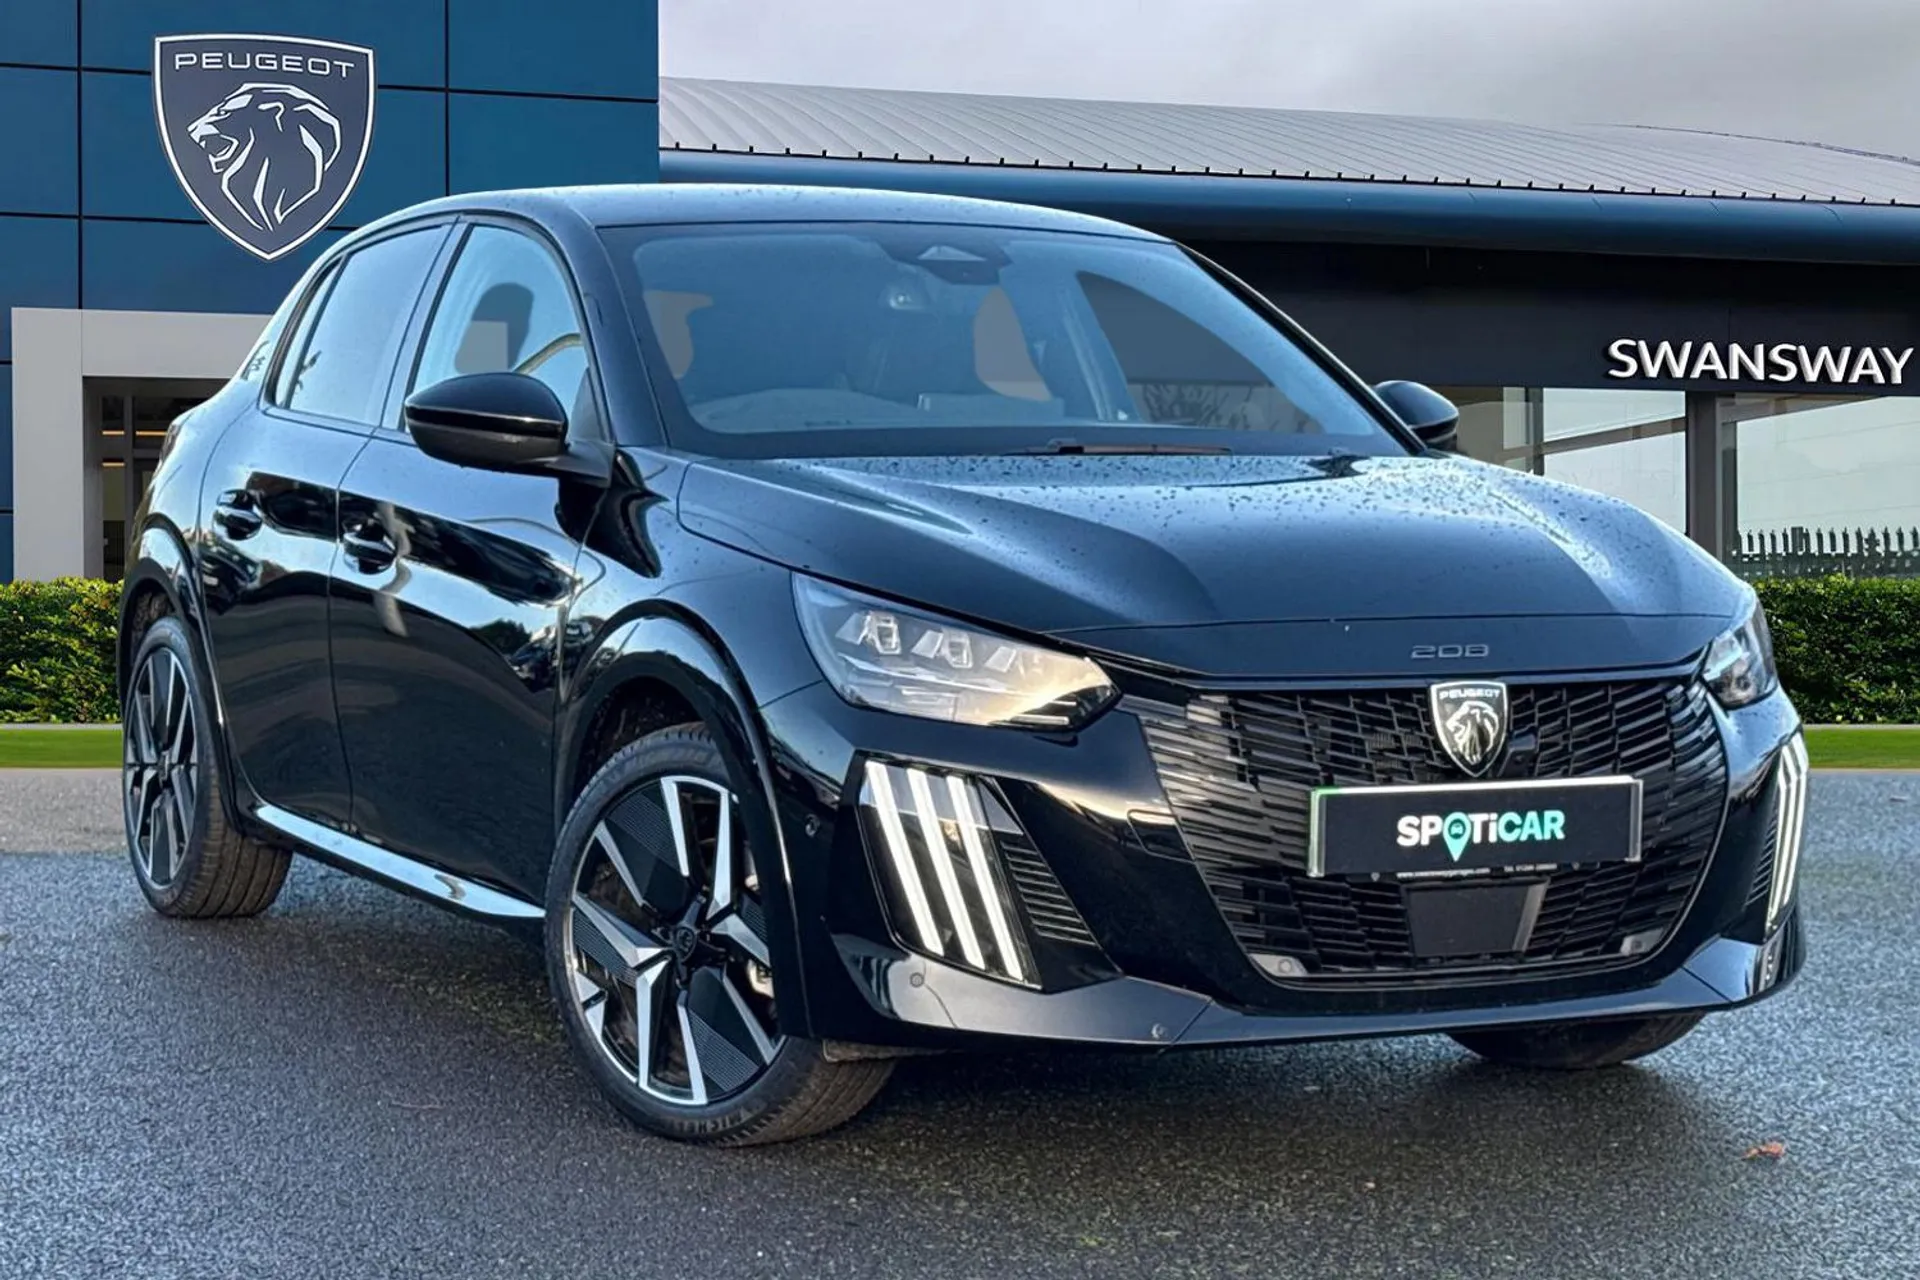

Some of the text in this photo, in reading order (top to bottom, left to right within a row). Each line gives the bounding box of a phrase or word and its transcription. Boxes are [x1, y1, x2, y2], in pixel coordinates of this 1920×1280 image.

[174, 52, 355, 78] PEUGEOT
[1607, 338, 1914, 384] SWANSWAY
[1411, 644, 1489, 658] 208
[1439, 688, 1501, 700] PEUGEOT
